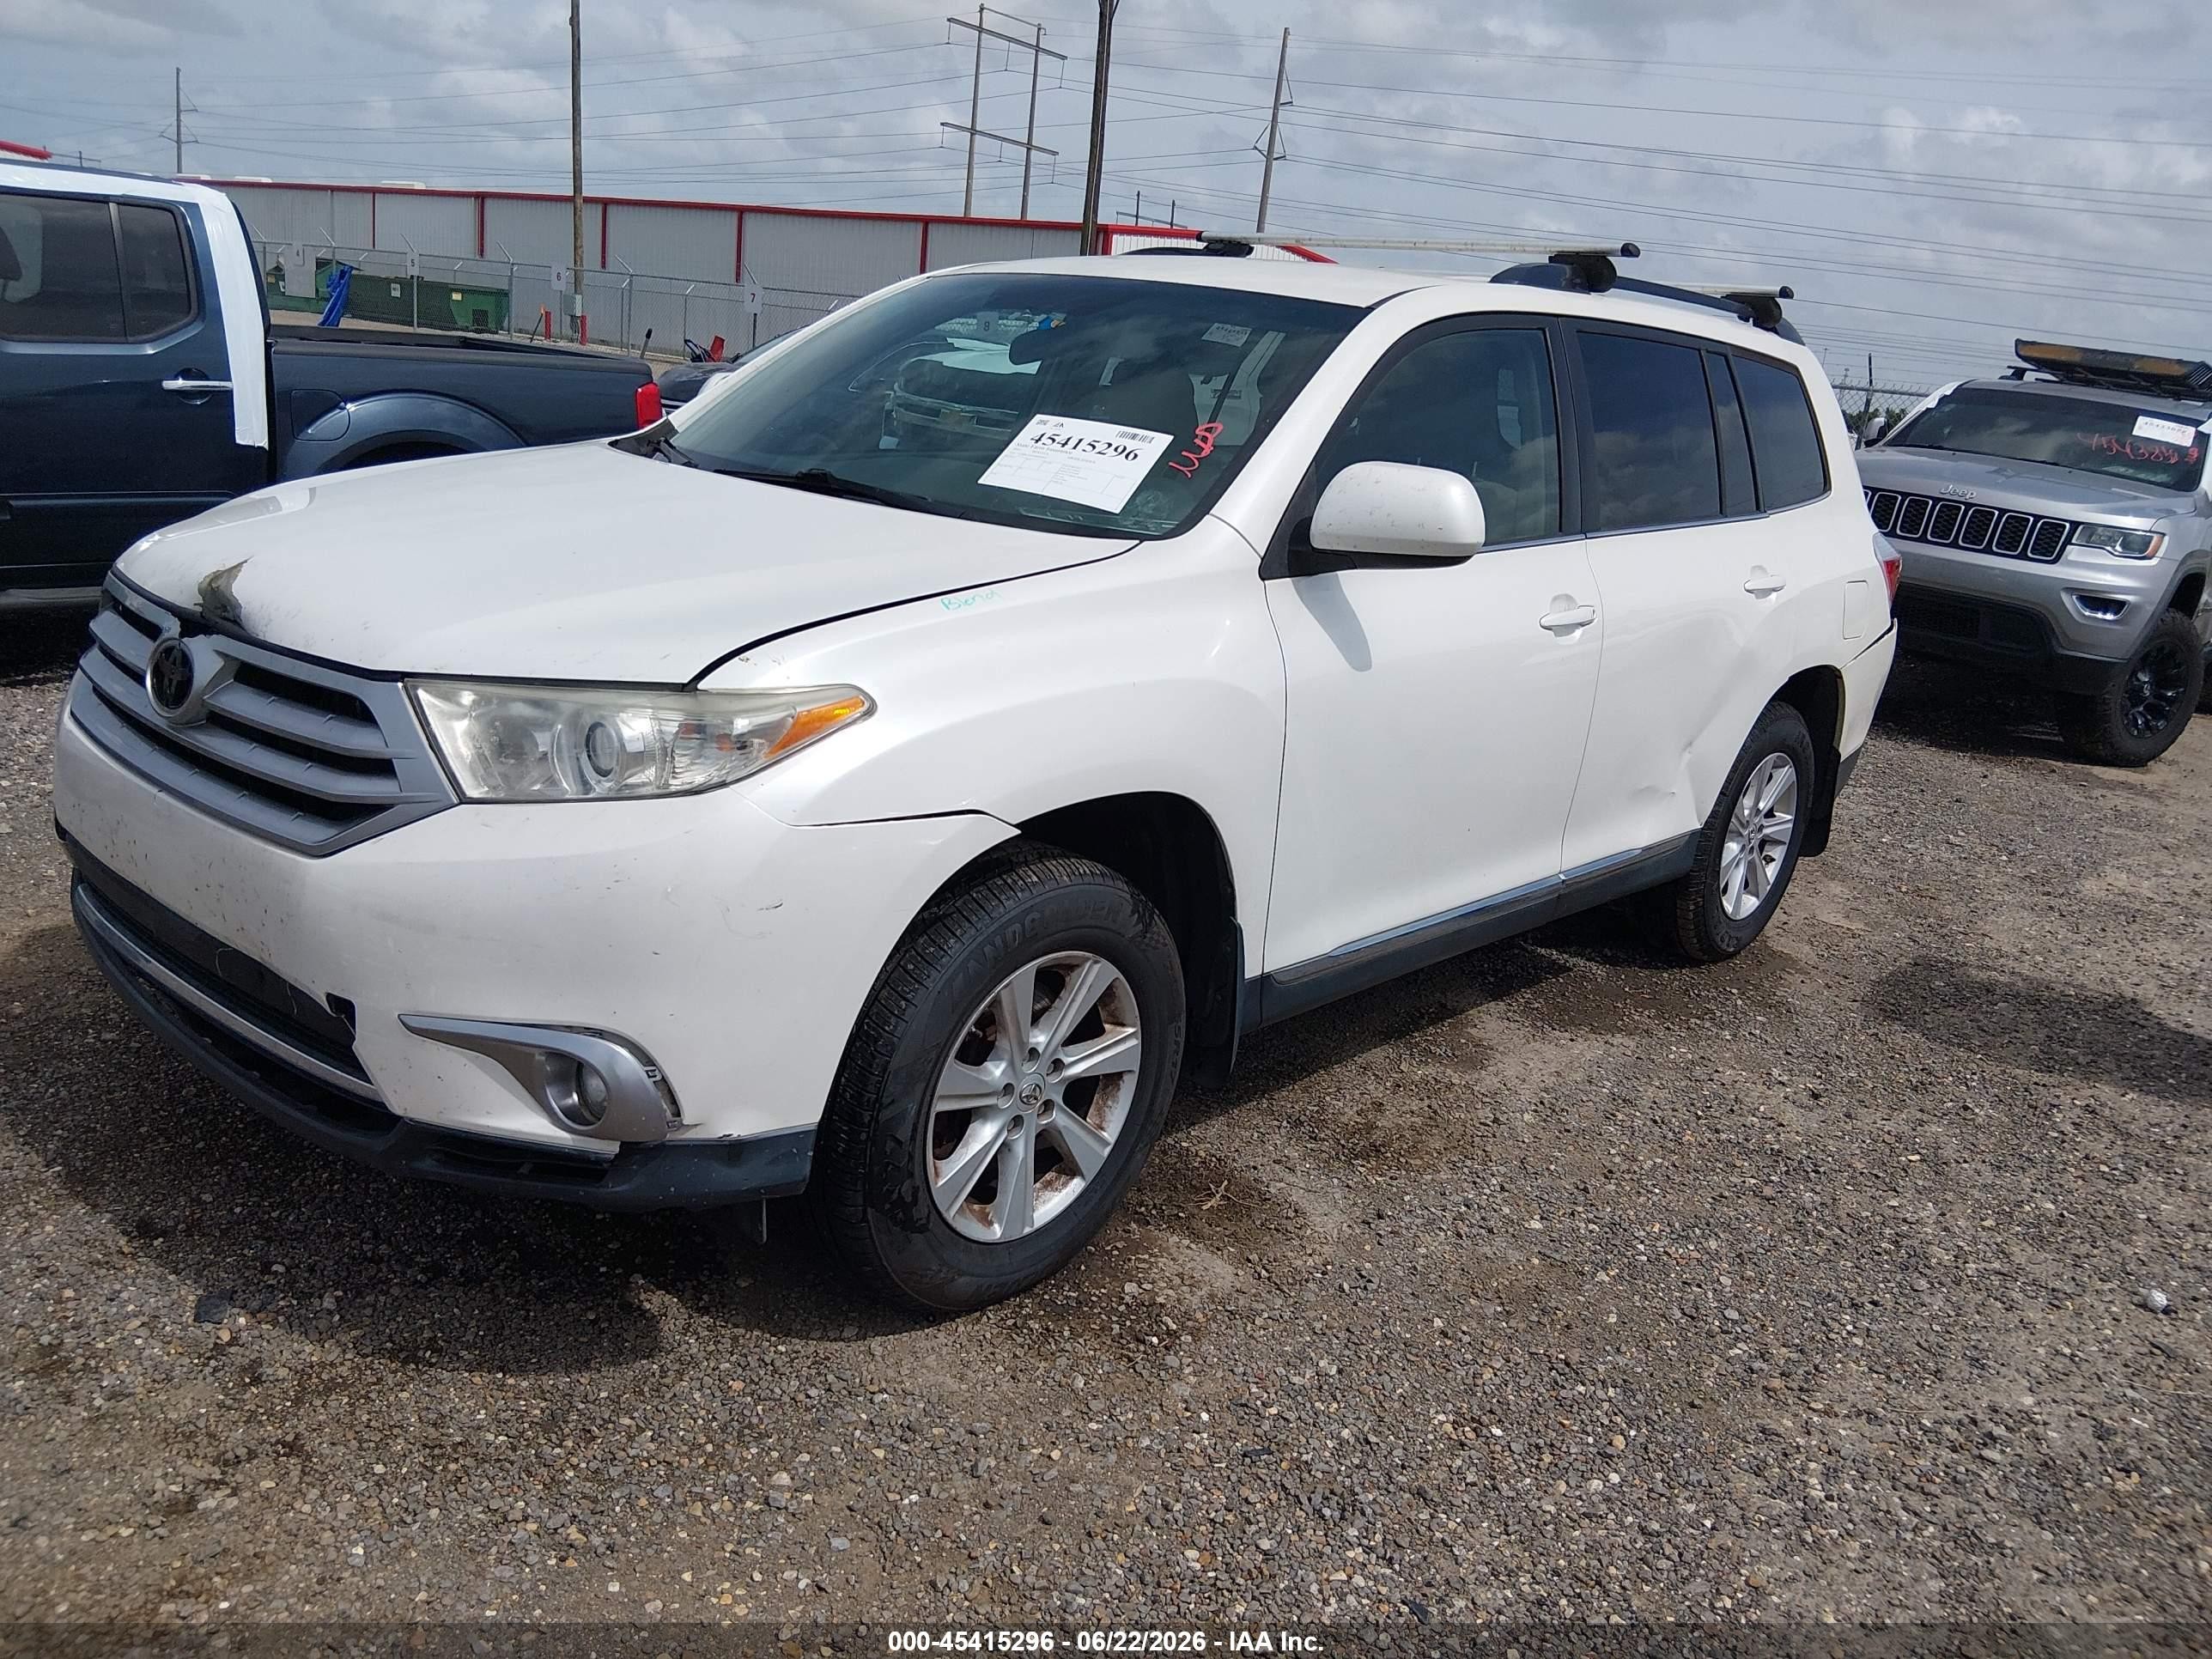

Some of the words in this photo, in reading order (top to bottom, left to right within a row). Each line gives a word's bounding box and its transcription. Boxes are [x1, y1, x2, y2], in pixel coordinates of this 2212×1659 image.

[410, 258, 416, 267] 5
[556, 271, 562, 282] 6
[750, 293, 756, 303] 7
[1030, 432, 1139, 461] 45415296
[1940, 484, 1977, 501] Jeep
